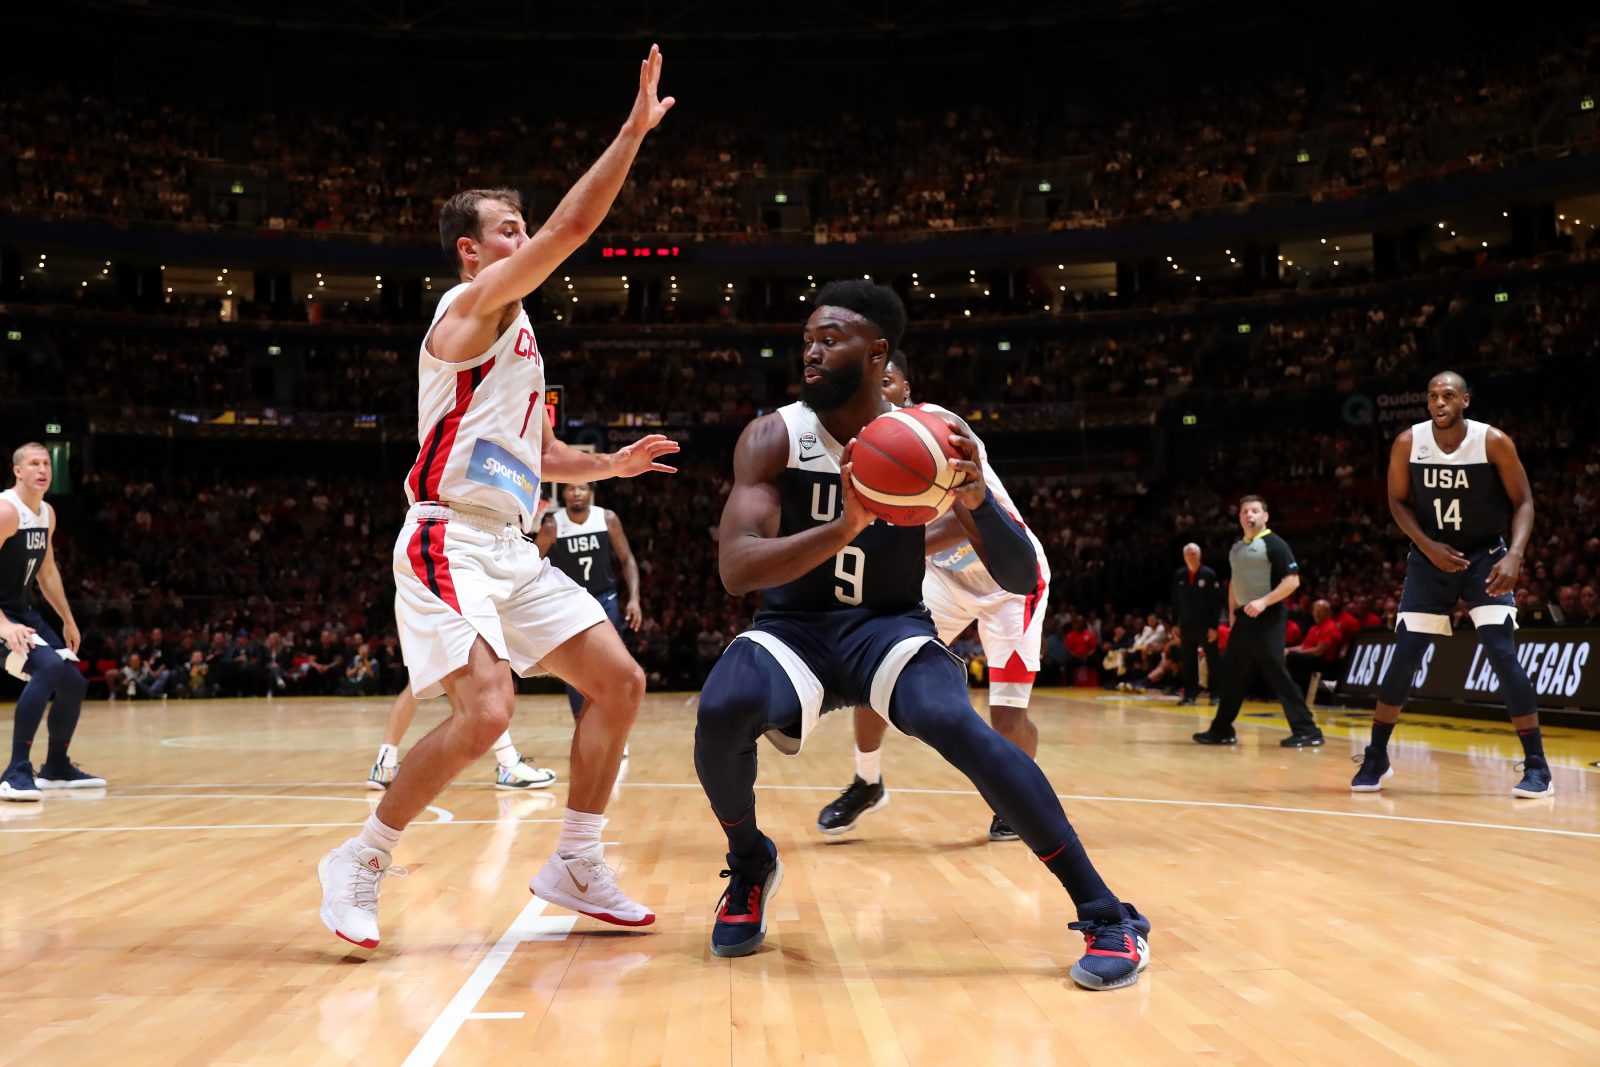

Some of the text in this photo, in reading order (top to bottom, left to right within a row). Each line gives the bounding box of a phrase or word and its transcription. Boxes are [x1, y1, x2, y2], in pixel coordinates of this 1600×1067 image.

[514, 328, 540, 367] CA
[519, 391, 539, 439] 1
[1423, 467, 1469, 489] USA
[1432, 497, 1463, 531] 14
[26, 531, 47, 550] USA
[567, 534, 600, 553] USA
[578, 556, 593, 581] 7
[834, 545, 866, 607] 9
[1346, 643, 1382, 687] LAS
